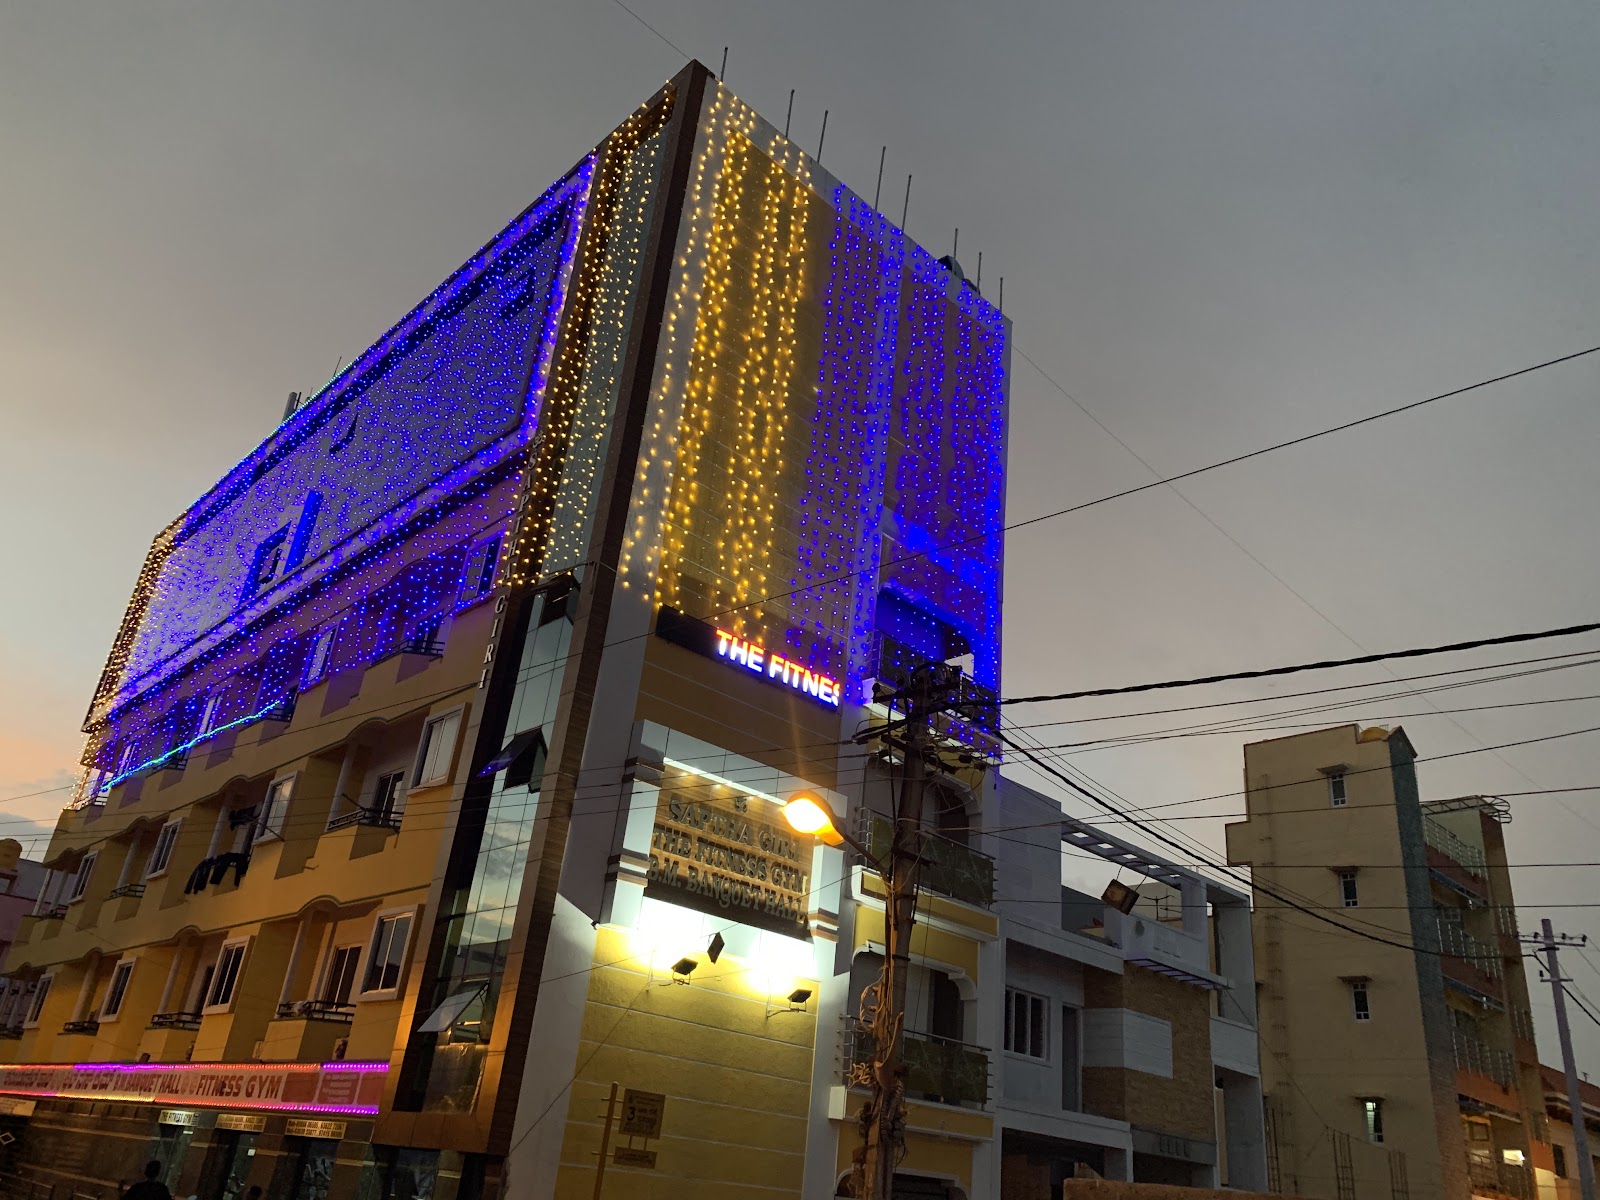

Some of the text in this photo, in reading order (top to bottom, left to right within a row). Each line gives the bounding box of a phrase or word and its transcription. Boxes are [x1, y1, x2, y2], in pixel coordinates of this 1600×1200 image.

[478, 452, 537, 689] SAPTHA GIRI
[716, 629, 765, 673] THE
[652, 827, 808, 895] THE FITNESS GYM
[668, 798, 754, 847] SAPTHA
[758, 827, 800, 862] GIRI
[646, 856, 808, 924] B.M. BANQUET HALL
[158, 1073, 182, 1094] HALL
[196, 1075, 283, 1099] FITNESS GYM
